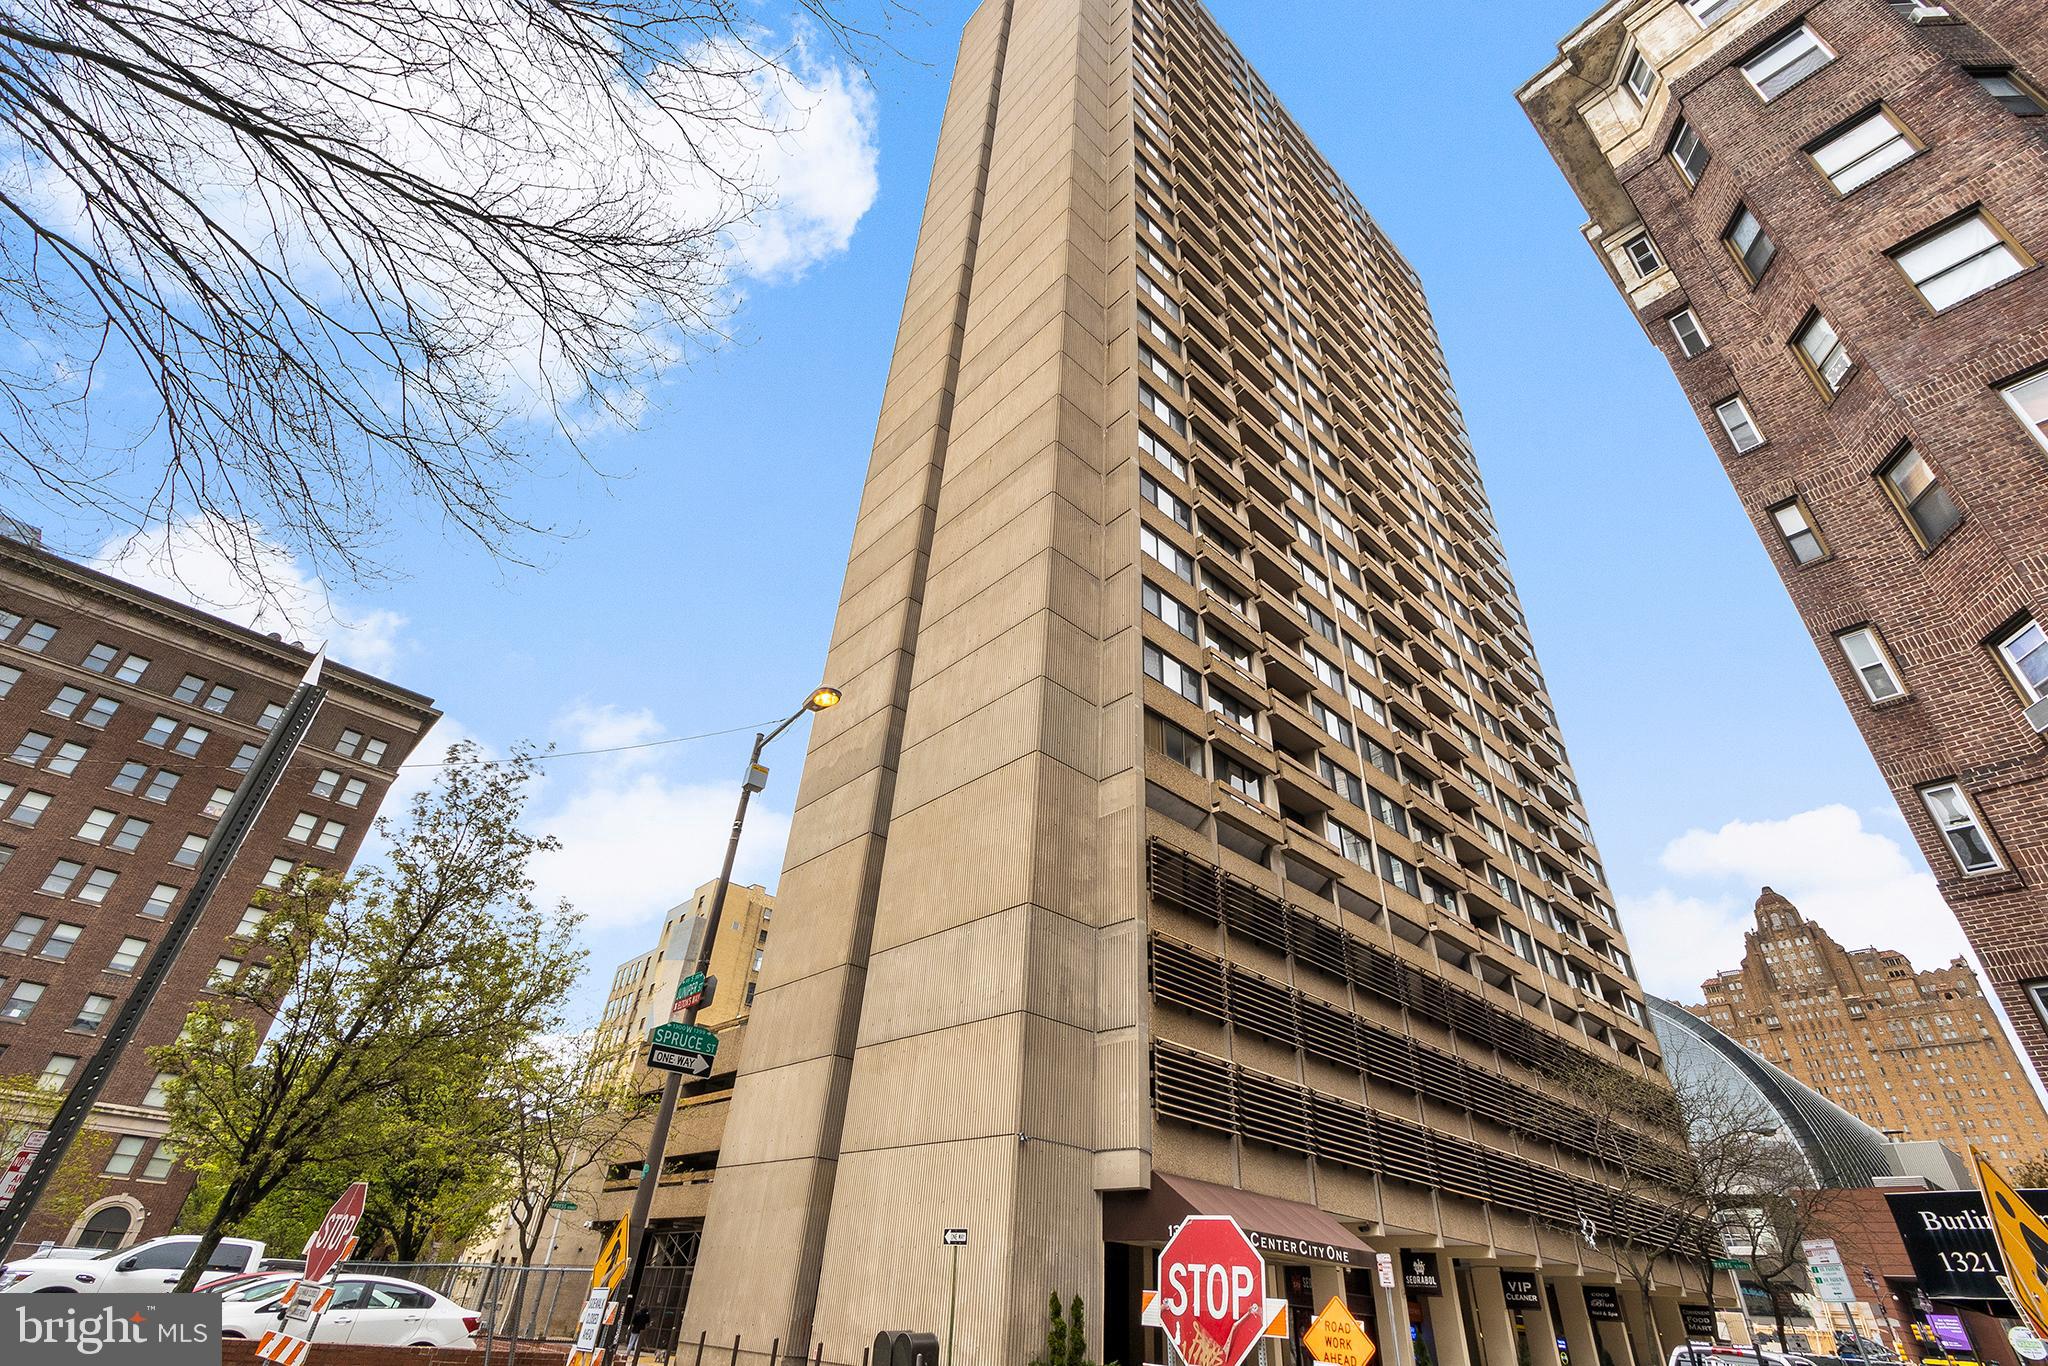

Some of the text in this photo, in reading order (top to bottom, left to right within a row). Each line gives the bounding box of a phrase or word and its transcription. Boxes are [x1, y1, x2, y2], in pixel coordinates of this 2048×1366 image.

[686, 1026, 693, 1034] W
[655, 1029, 716, 1053] SPRUCE ST
[656, 1052, 696, 1068] ONE WAY
[11, 1174, 26, 1183] AN
[315, 1213, 356, 1251] STOP
[1250, 1232, 1350, 1263] CENTER CITY ONE
[1938, 1252, 1999, 1272] 1321
[1405, 1275, 1437, 1285] SEORABOL
[1507, 1281, 1532, 1292] VIP
[1167, 1262, 1254, 1320] STOP
[1505, 1293, 1538, 1302] CLEANER
[1324, 1320, 1351, 1334] ROAD
[1688, 1323, 1712, 1332] MART
[1324, 1335, 1352, 1350] WORK
[1323, 1352, 1357, 1366] AHEAD
